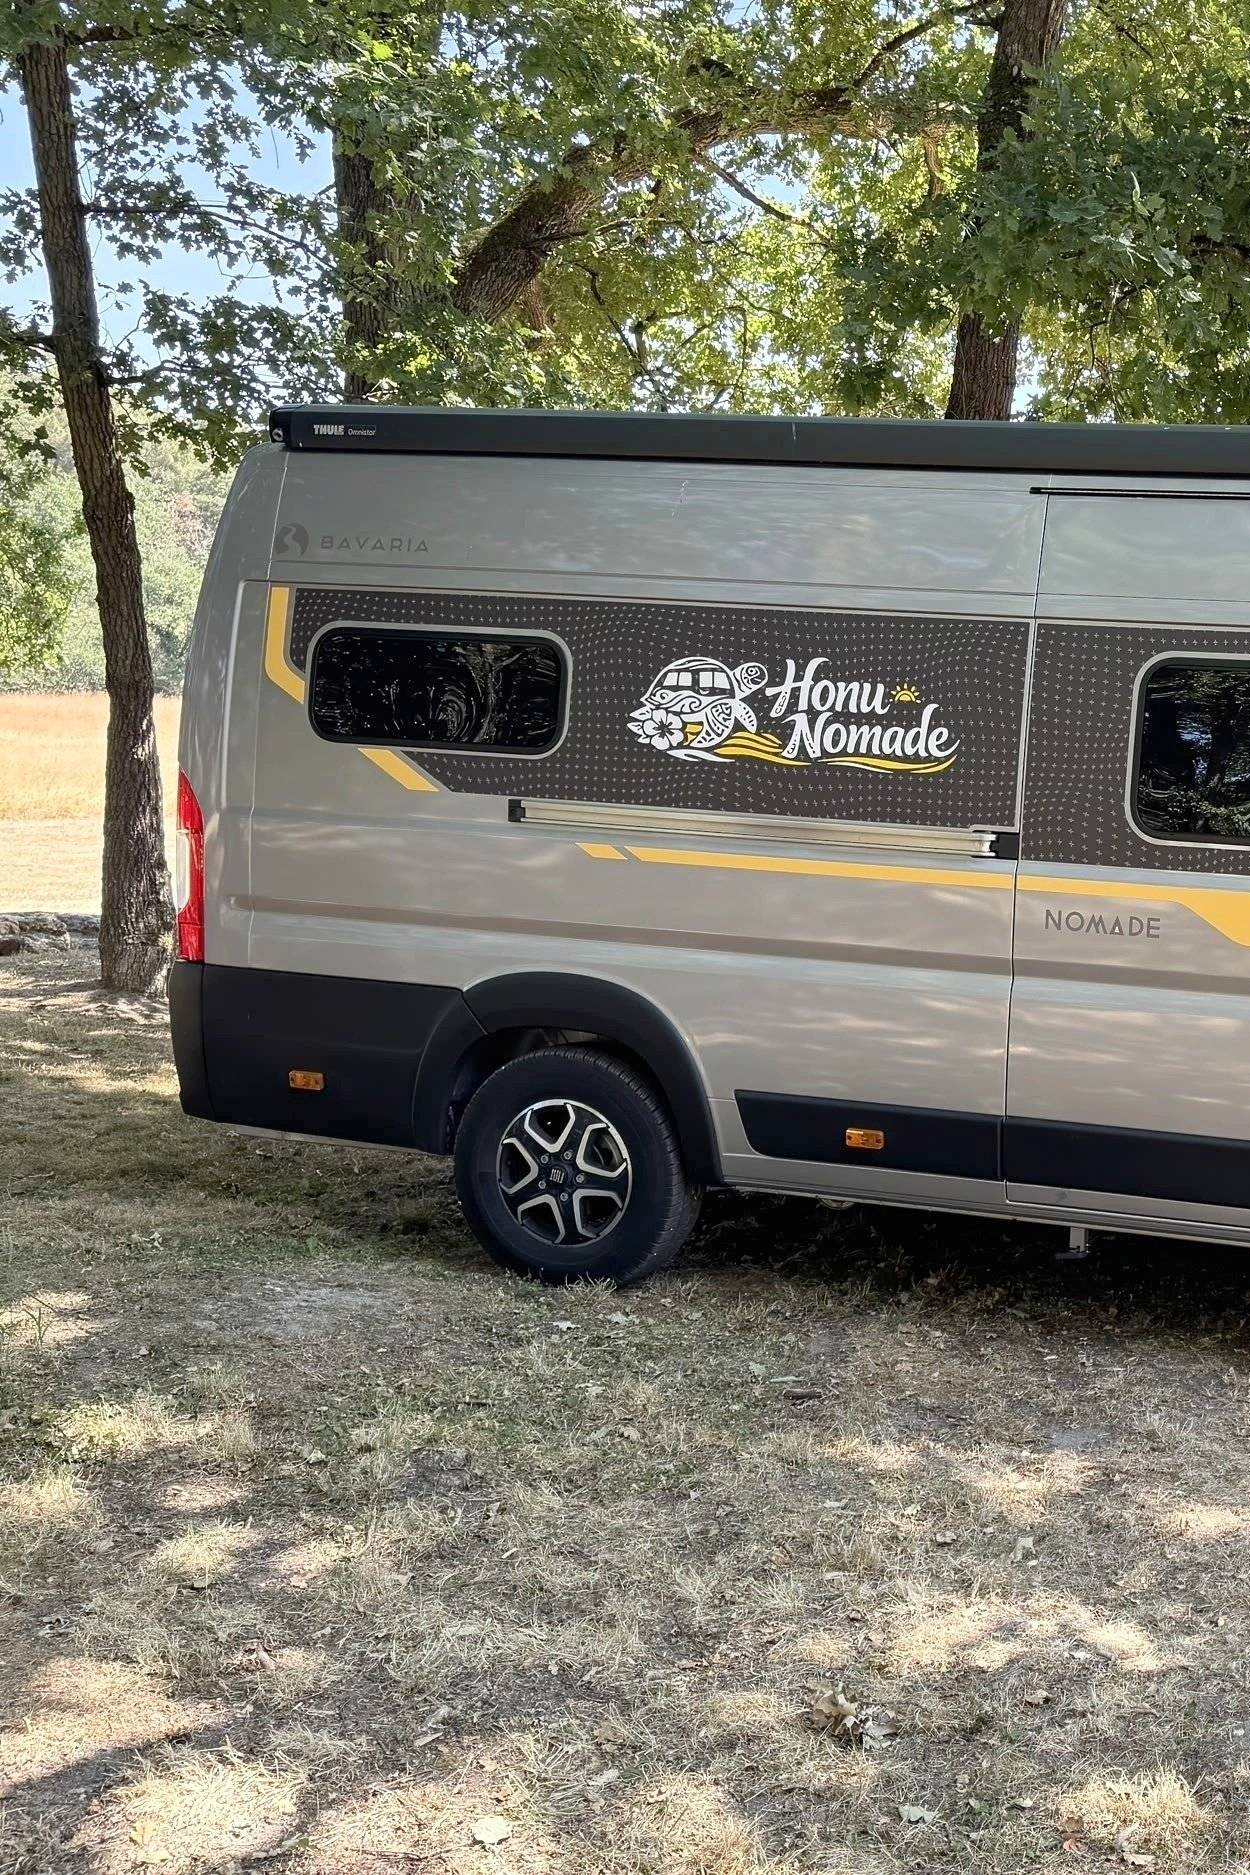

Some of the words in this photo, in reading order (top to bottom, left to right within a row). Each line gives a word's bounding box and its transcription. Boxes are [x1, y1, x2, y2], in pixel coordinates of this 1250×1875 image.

[313, 424, 345, 436] THULE
[320, 535, 429, 553] BAVARIA
[765, 657, 891, 718] Honu
[781, 703, 961, 760] Nomade
[1044, 909, 1161, 939] NOMADE
